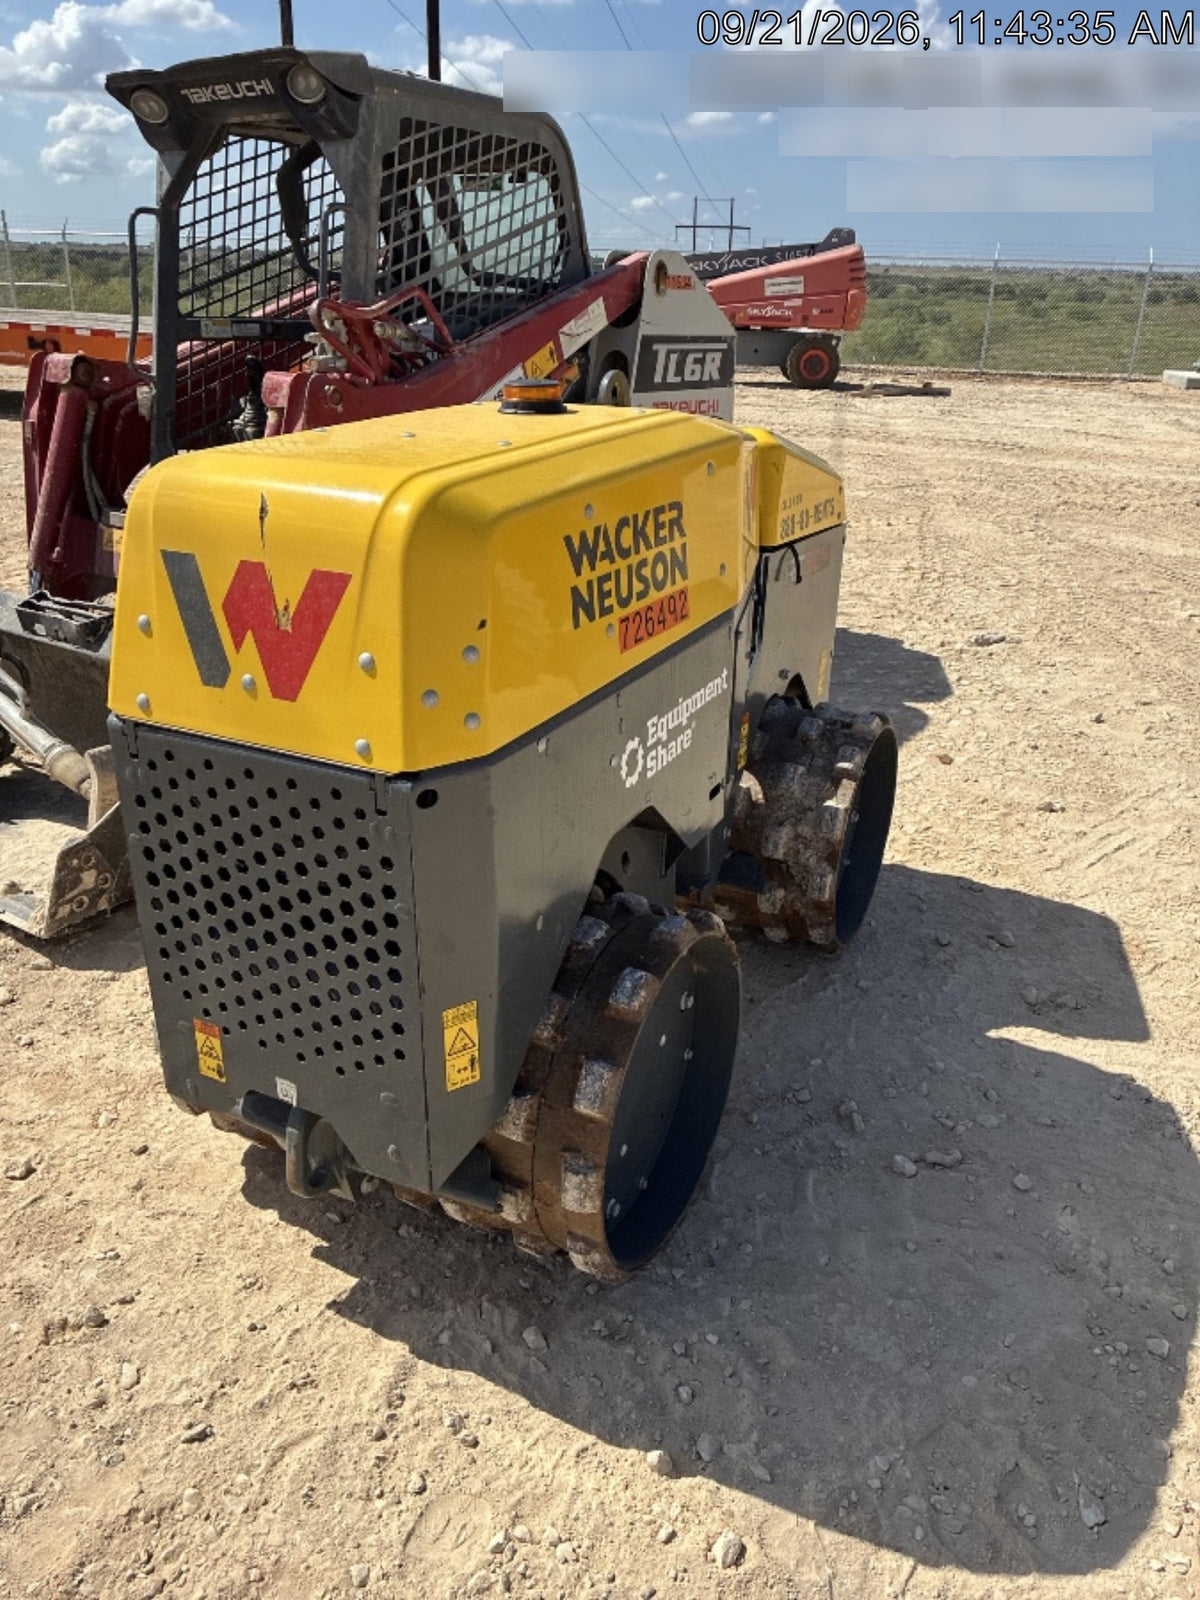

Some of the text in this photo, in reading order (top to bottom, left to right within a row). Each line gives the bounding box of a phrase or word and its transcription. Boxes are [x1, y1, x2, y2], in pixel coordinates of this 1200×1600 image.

[688, 252, 769, 273] SKYJACK
[746, 305, 794, 318] SKYJACK
[652, 342, 729, 384] TL6R
[563, 501, 687, 577] WACKER
[570, 542, 690, 630] NEUSON
[619, 589, 689, 651] 726492
[646, 667, 729, 748] Equipment
[646, 727, 693, 778] Share
